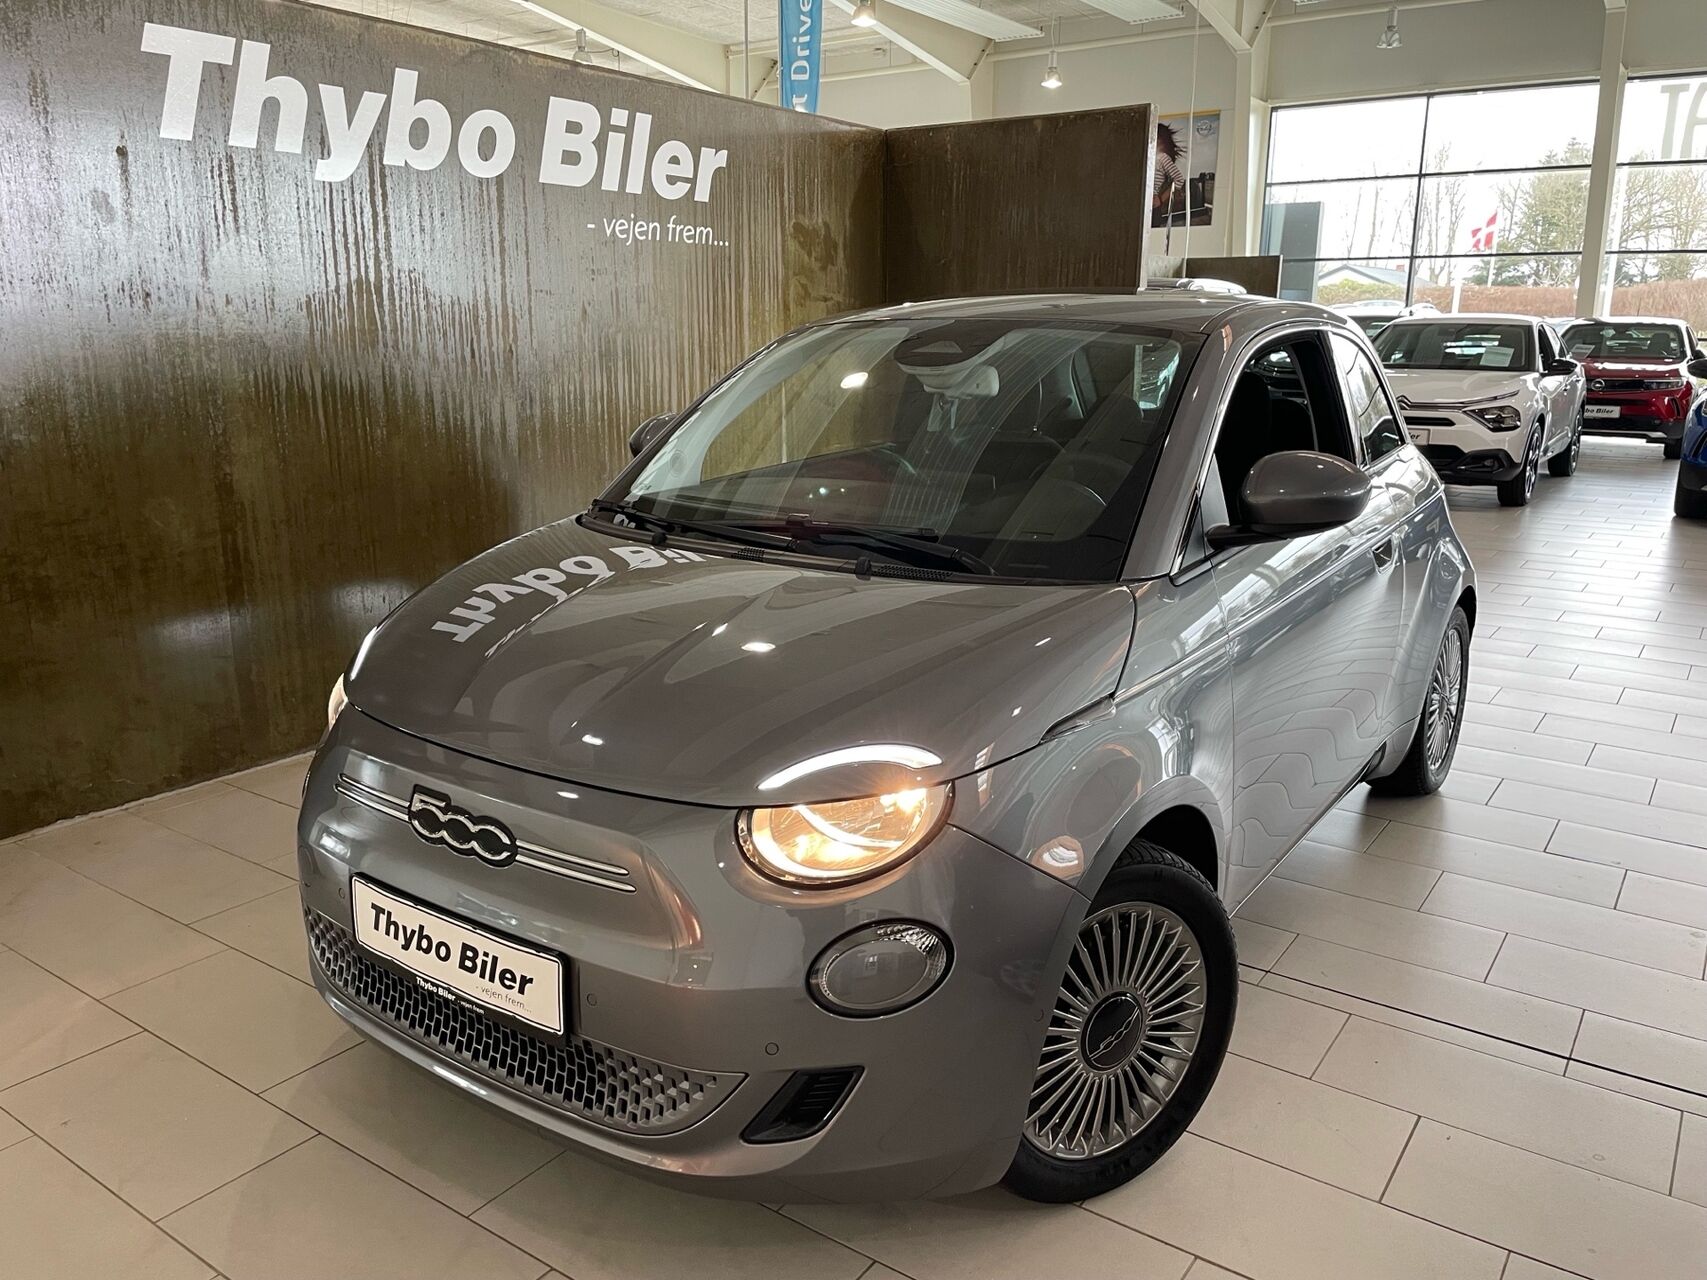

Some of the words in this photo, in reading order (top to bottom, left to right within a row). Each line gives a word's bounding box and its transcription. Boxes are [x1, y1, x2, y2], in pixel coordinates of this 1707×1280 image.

[141, 22, 516, 183] Thybo
[538, 96, 727, 203] Biler
[603, 213, 660, 246] vejen
[667, 214, 729, 247] frem...
[409, 787, 514, 864] 500
[371, 903, 452, 962] Thybo
[458, 942, 534, 996] Biler
[416, 976, 437, 993] Thybo
[438, 987, 456, 1001] Biler
[481, 985, 503, 1000] vejen
